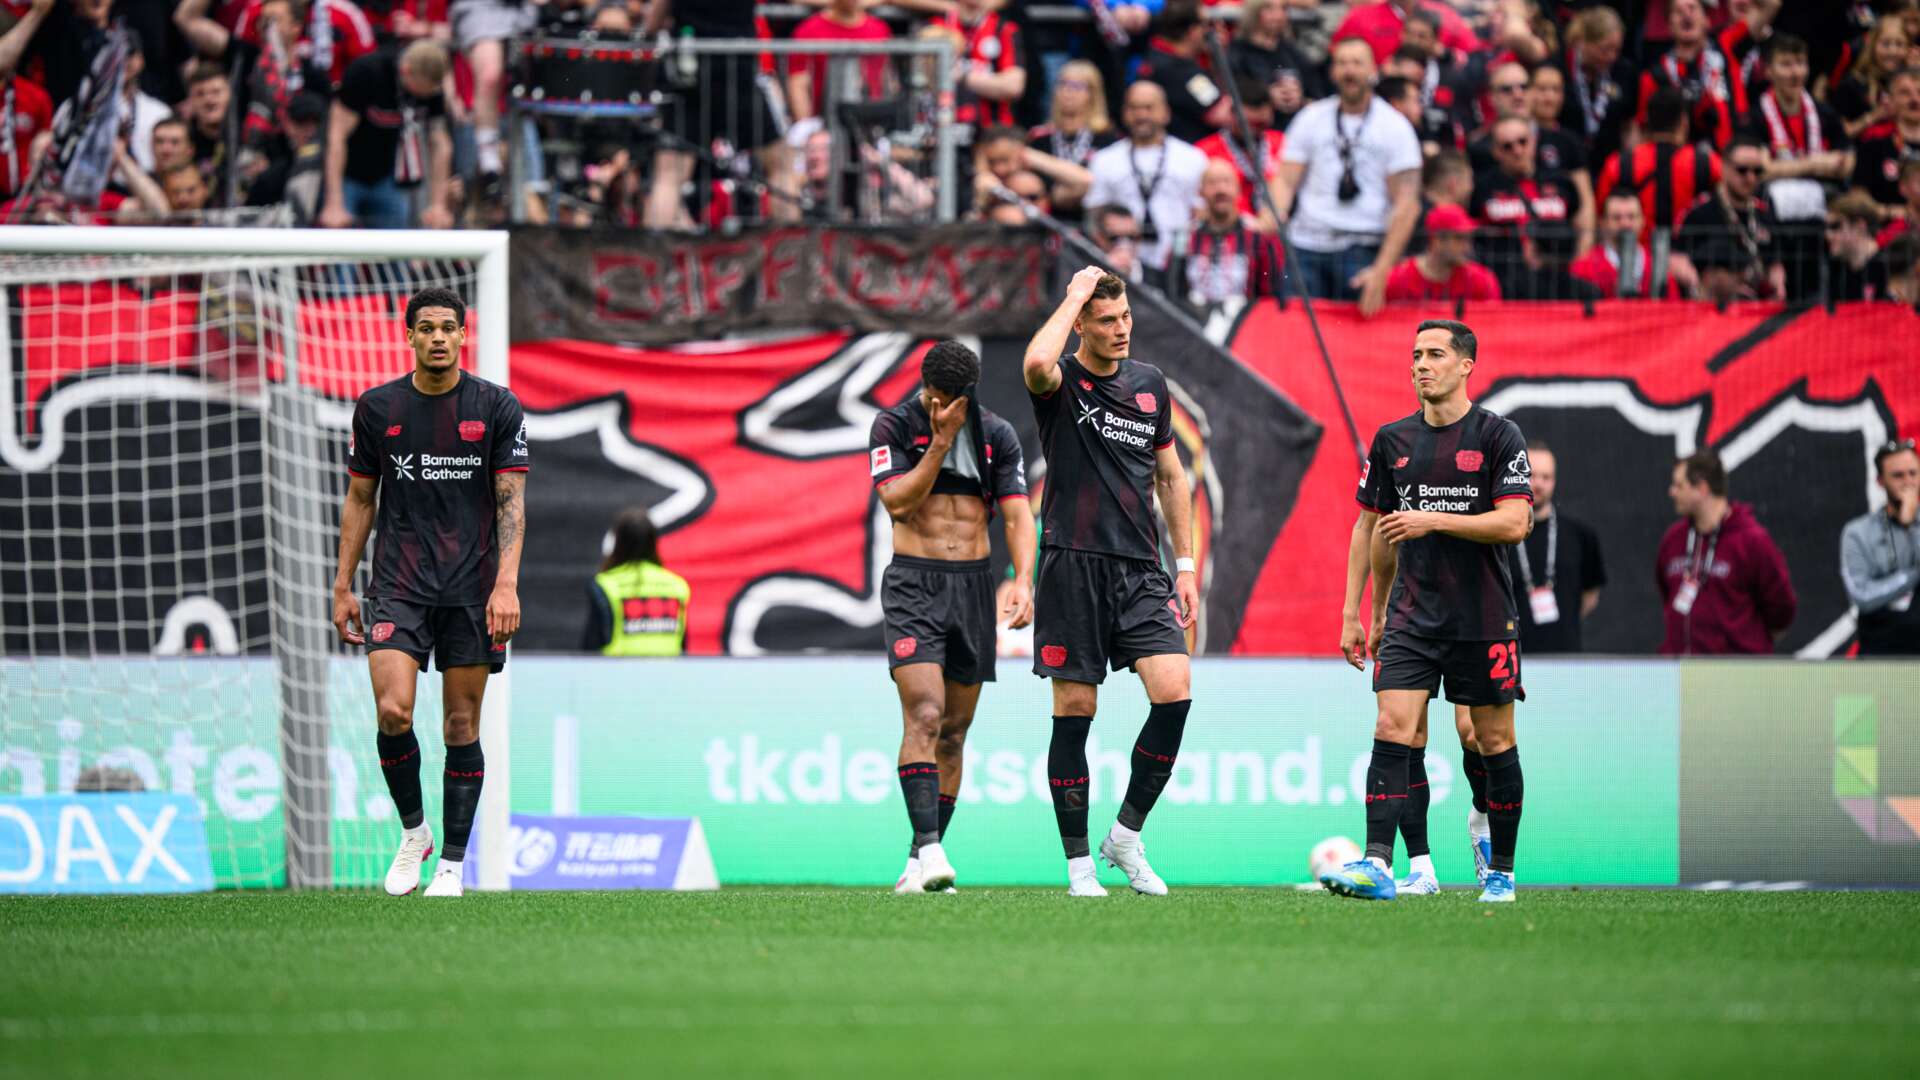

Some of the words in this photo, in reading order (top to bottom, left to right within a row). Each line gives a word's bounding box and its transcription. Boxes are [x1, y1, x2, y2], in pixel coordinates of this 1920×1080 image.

[1104, 411, 1156, 436] Barmenia
[1101, 426, 1148, 448] Gothaer
[421, 454, 482, 466] Barmenia
[421, 469, 473, 480] Gothaer
[1418, 484, 1479, 497] Barmenia
[1418, 498, 1471, 512] Gothaer
[1488, 640, 1518, 679] 21
